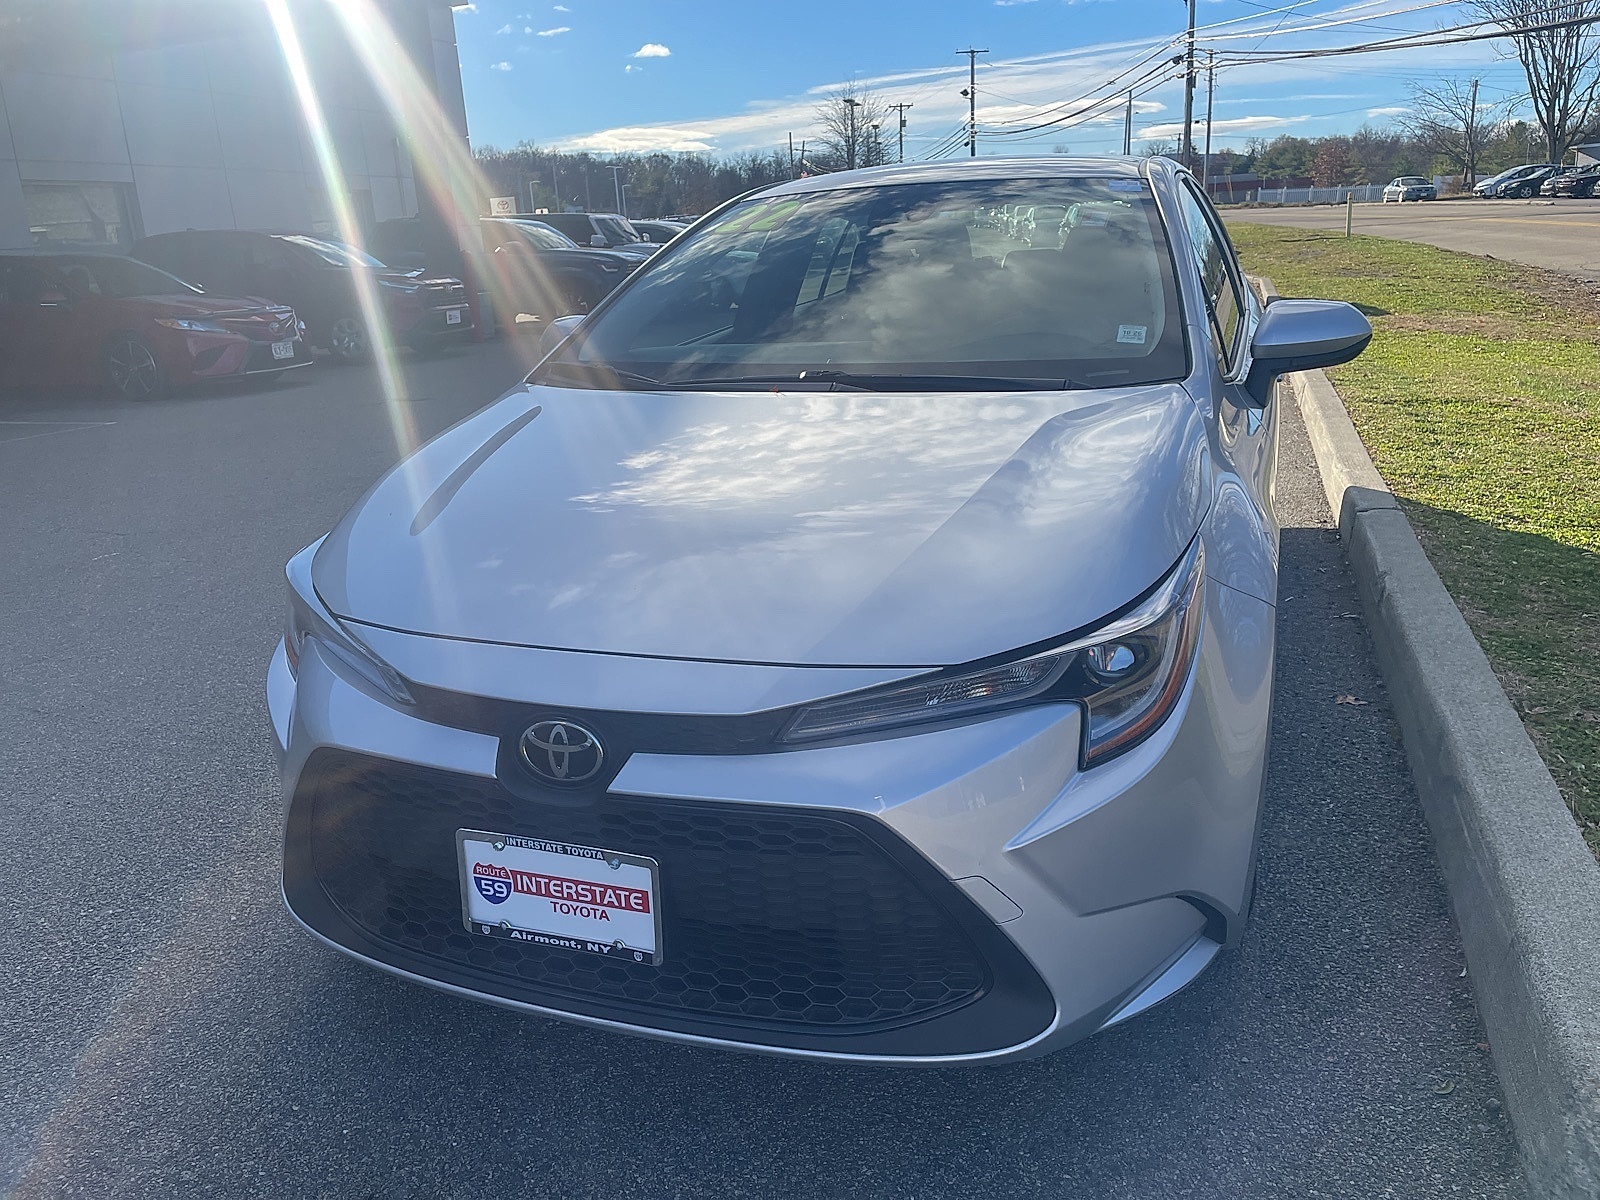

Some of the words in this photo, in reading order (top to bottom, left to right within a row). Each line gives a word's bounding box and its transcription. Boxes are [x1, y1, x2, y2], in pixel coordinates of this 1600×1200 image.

[715, 201, 800, 233] 22
[506, 836, 564, 854] INTERSTATE
[565, 847, 604, 860] TOYOTA
[476, 866, 507, 878] ROUTE
[481, 880, 508, 897] 59
[516, 874, 644, 910] INTERSTATE
[550, 901, 611, 922] TOYOTA
[510, 930, 582, 950] Airmont,
[587, 943, 613, 954] NY
